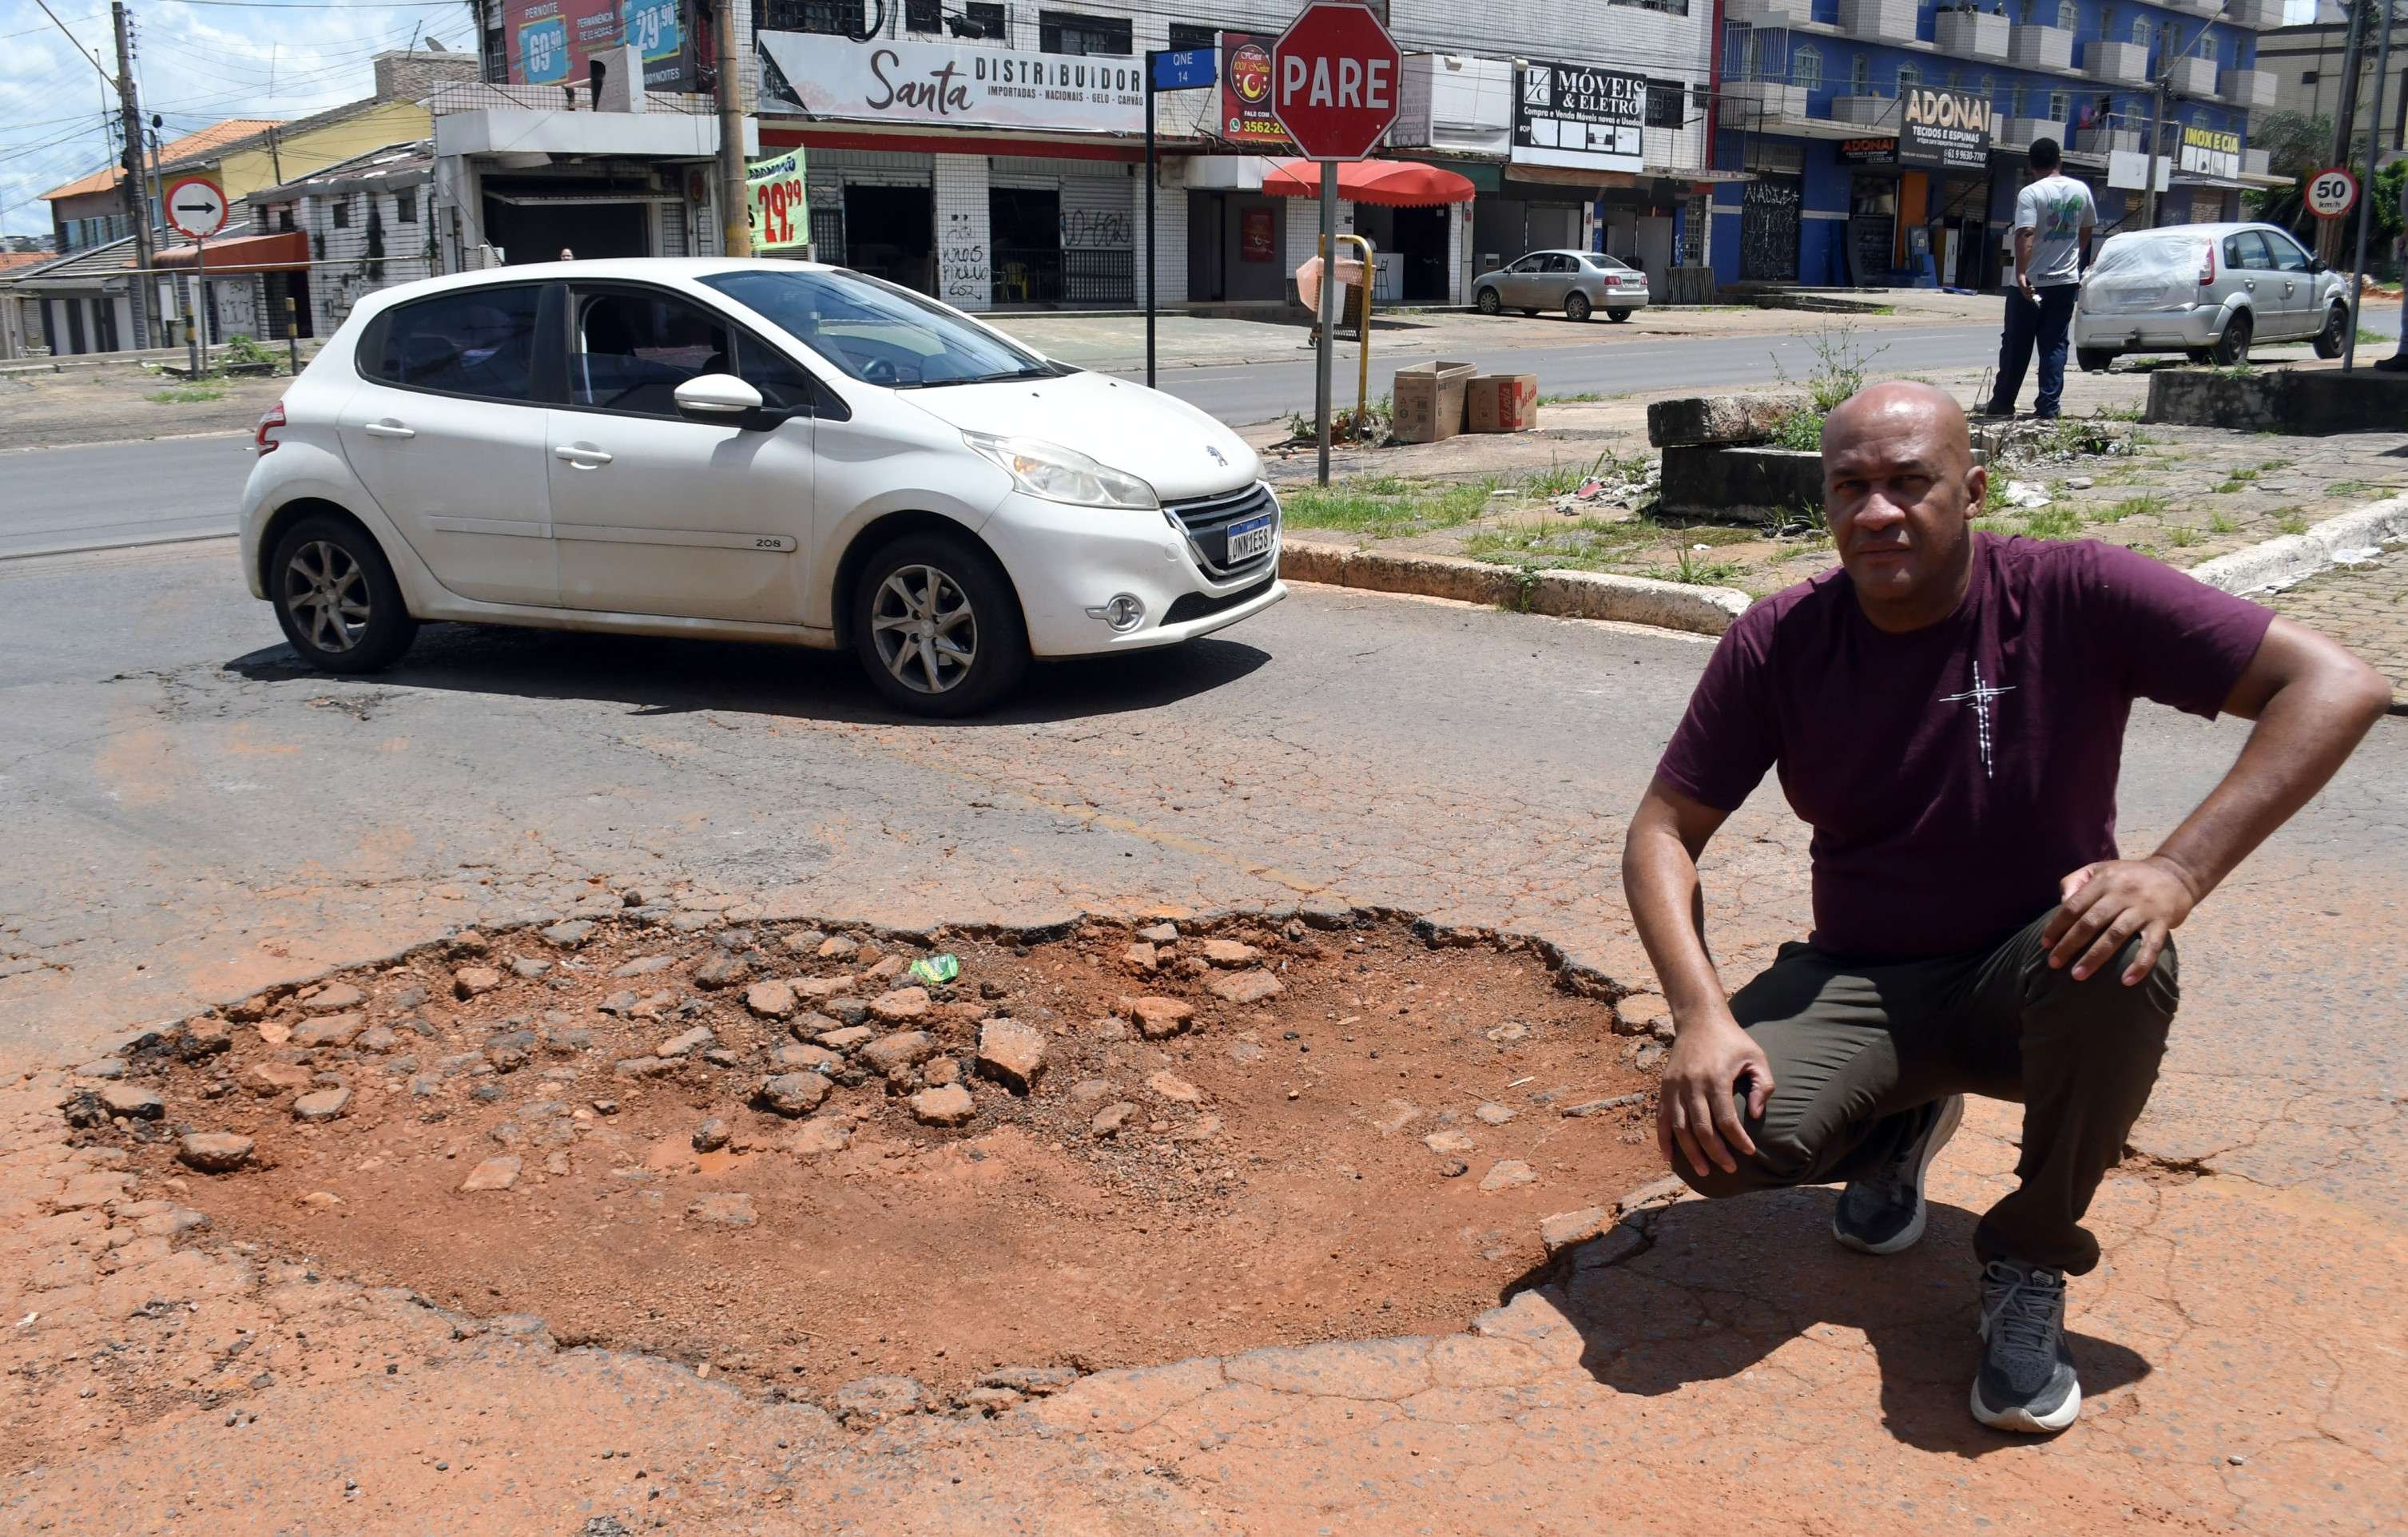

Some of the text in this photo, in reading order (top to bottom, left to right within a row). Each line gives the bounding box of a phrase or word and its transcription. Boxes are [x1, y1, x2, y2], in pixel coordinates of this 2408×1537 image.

[525, 2, 558, 18] PERNOITE
[1173, 53, 1194, 66] QNE
[865, 49, 974, 115] Santa
[976, 57, 1141, 92] DISTRIBUIDOR
[1178, 71, 1188, 82] 14
[1283, 55, 1392, 109] PARE
[1557, 68, 1647, 100] MÓVEIS
[987, 85, 1143, 107] IMPORTADAS NACIONAIS GELO CARVÃO
[1563, 93, 1640, 115] & ELETRO
[1524, 106, 1548, 117] Compra
[1556, 109, 1576, 120] Venda
[1576, 113, 1597, 122] Móveis
[1621, 117, 1643, 127] Usados
[1904, 89, 1991, 133] ADONAI
[1912, 125, 1980, 144] TECIDOS E ESPUMAS
[2184, 127, 2239, 154] INOX E CIA
[1842, 139, 1893, 153] ADONAI
[1947, 149, 1955, 158] 61
[1955, 149, 1959, 159] 9
[2316, 181, 2346, 199] 50
[756, 538, 781, 548] 208
